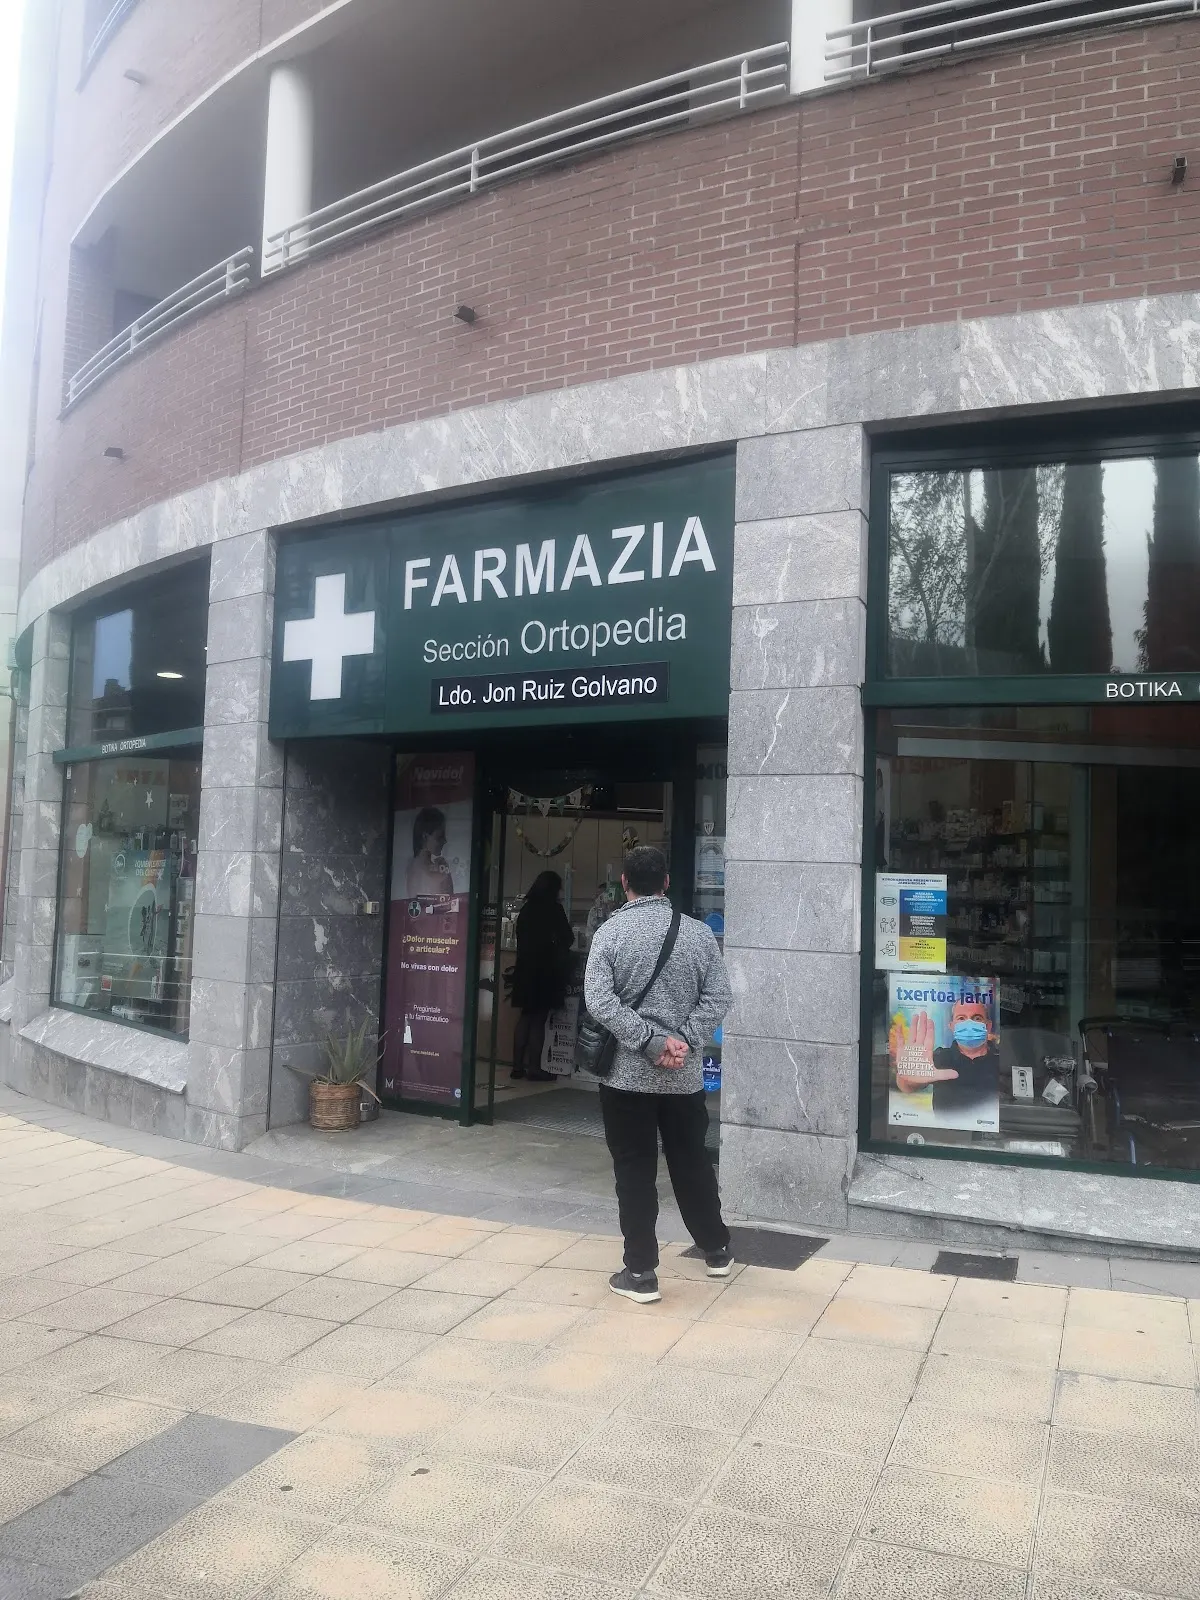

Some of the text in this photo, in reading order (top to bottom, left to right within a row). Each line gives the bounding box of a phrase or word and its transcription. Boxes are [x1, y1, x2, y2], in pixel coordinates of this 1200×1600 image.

[404, 516, 717, 610] FARMAZIA
[423, 607, 687, 663] Sección Ortopedia
[439, 673, 658, 706] Ldo. Jon Ruiz Golvano
[1106, 681, 1183, 698] BOTIKA
[402, 934, 459, 945] ¿Dolor muscular
[416, 945, 450, 954] articular?
[411, 963, 427, 971] vivas
[441, 965, 458, 973] dolor
[896, 986, 993, 1005] txertoa jarri
[897, 1062, 934, 1071] GRIPETIK
